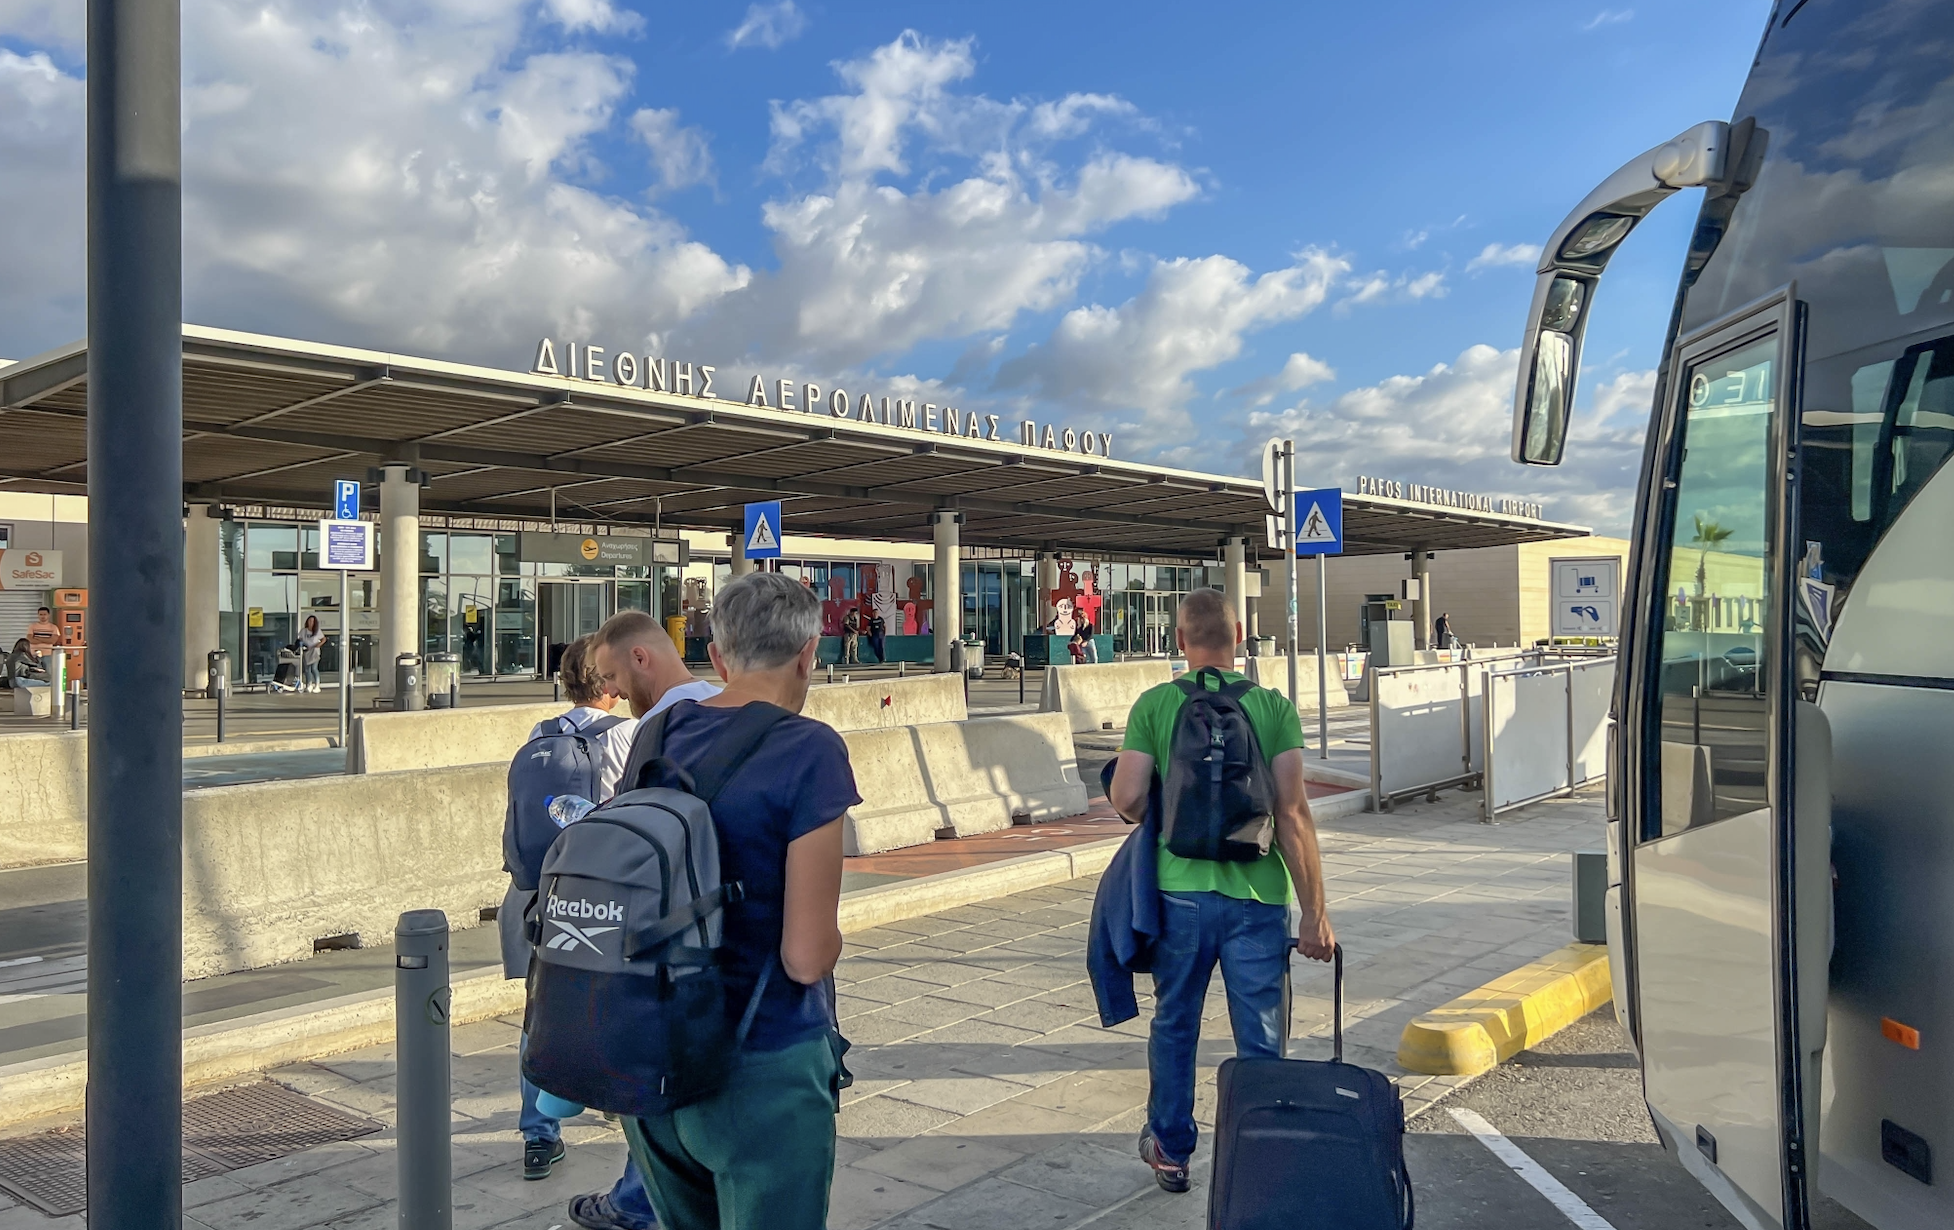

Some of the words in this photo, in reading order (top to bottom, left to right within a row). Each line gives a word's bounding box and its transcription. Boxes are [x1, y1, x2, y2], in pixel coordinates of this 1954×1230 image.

[533, 337, 717, 398] ΔΙΕΘΝΗΣ
[748, 374, 1000, 441] ΑΕΡΟΛΙΜΕΝΑΣ
[1021, 420, 1112, 457] ΠΑΦΟΥ
[342, 483, 354, 501] P
[1358, 476, 1402, 499] PAFOS
[1408, 484, 1494, 513] INTERNATIONAL
[1502, 499, 1543, 519] AIRPORT
[12, 570, 55, 579] SafeSac
[546, 894, 624, 922] Reebok
